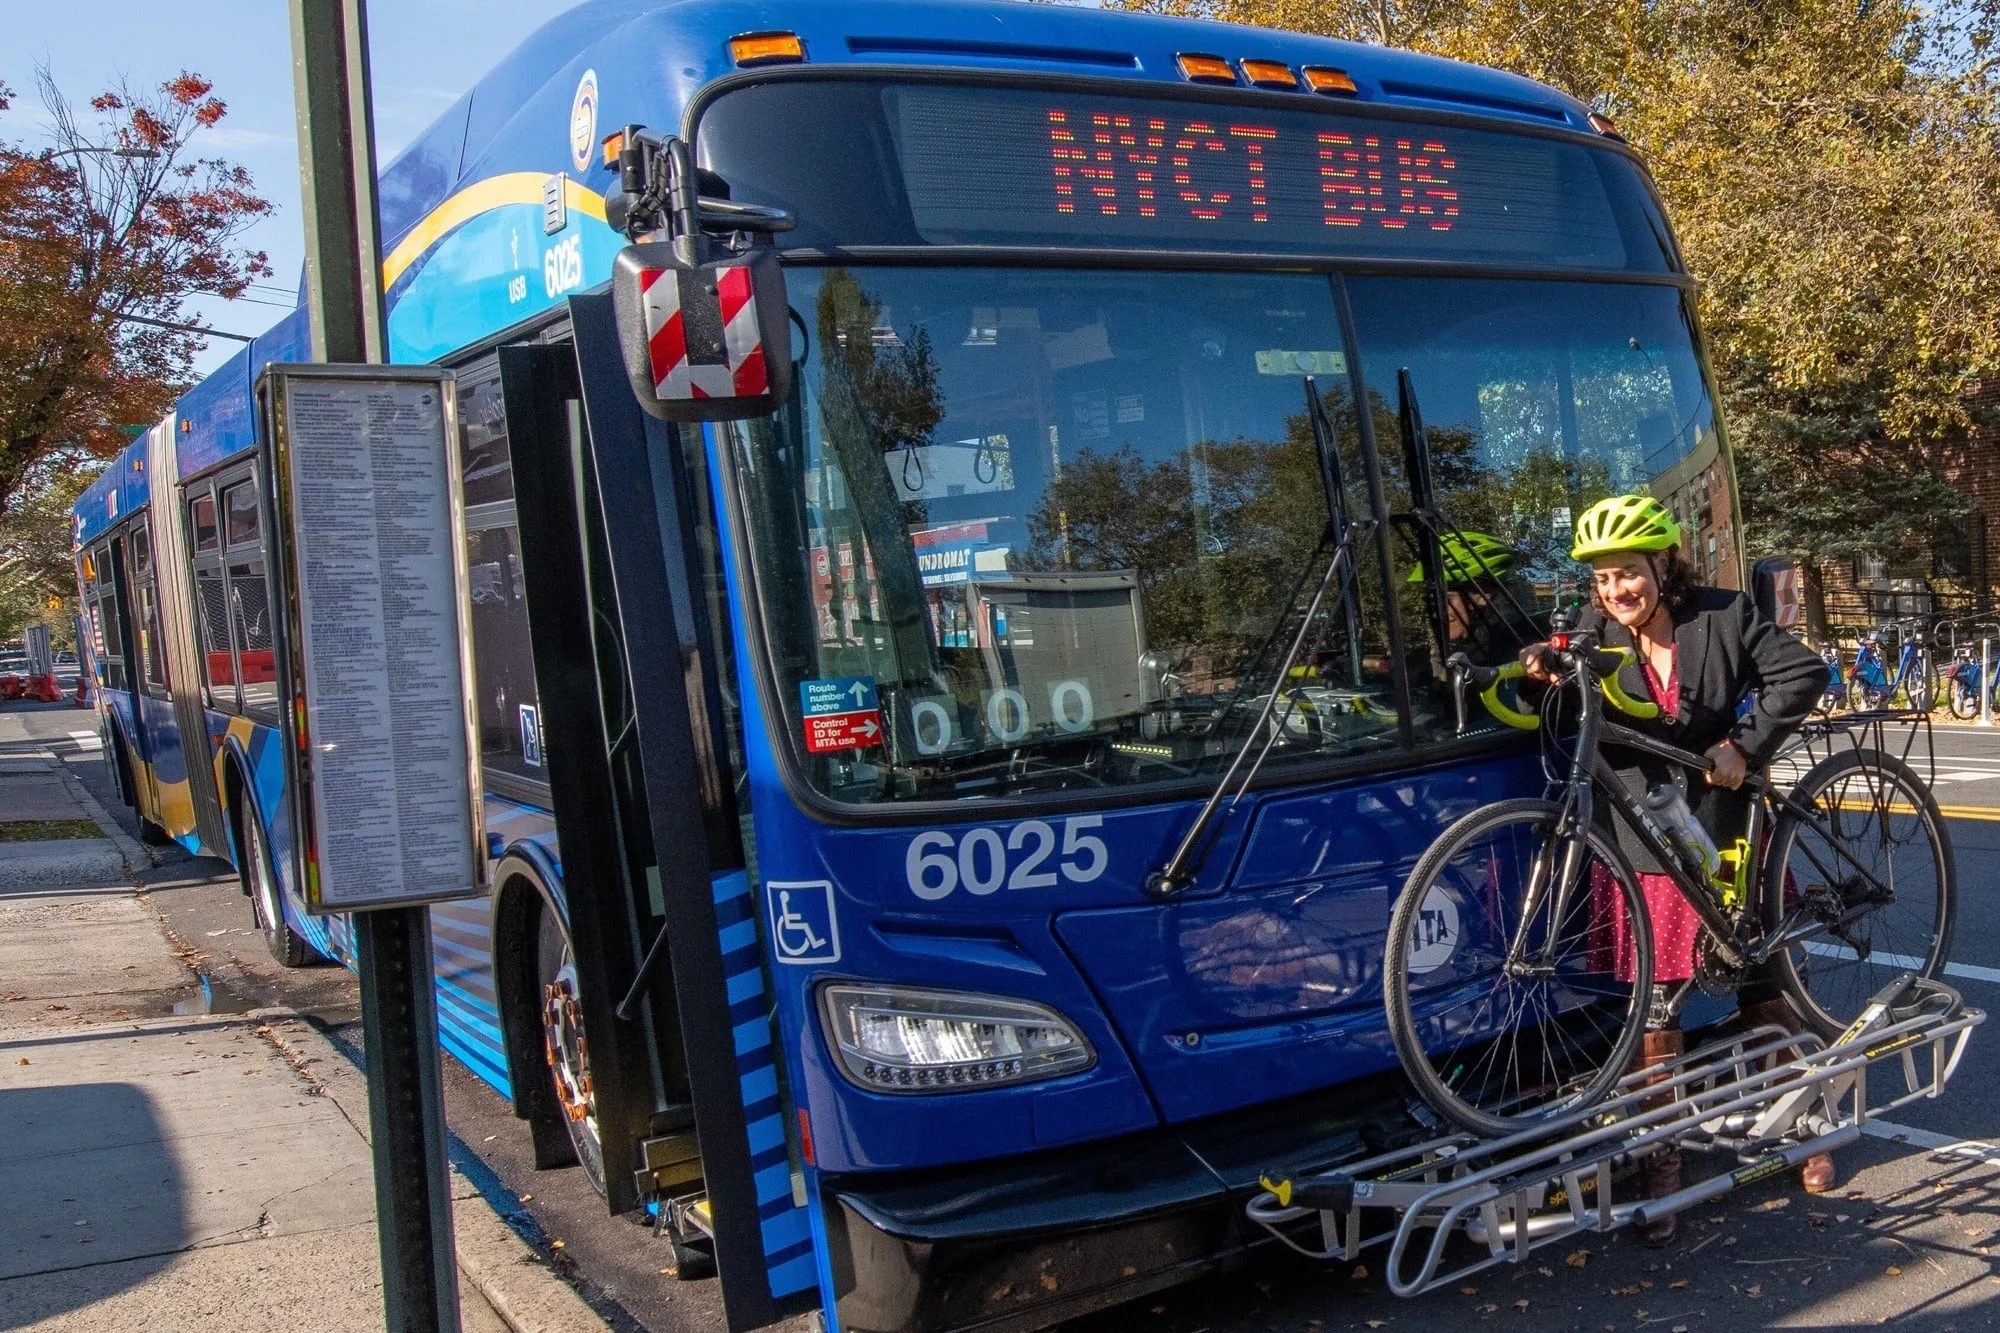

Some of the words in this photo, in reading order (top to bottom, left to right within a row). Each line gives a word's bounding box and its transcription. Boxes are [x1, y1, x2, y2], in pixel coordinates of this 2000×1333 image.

[1048, 109, 1278, 222] NYCT
[1316, 132, 1460, 232] BUS
[545, 233, 582, 299] 6025
[508, 274, 527, 304] USB
[918, 548, 971, 572] UNDROMAT
[809, 684, 836, 693] Route
[810, 693, 845, 702] number
[811, 703, 840, 711] above
[813, 718, 848, 728] Control
[814, 729, 825, 738] ID
[827, 729, 842, 737] for
[816, 738, 837, 747] MTA
[838, 737, 856, 745] use
[905, 814, 1109, 901] 6025
